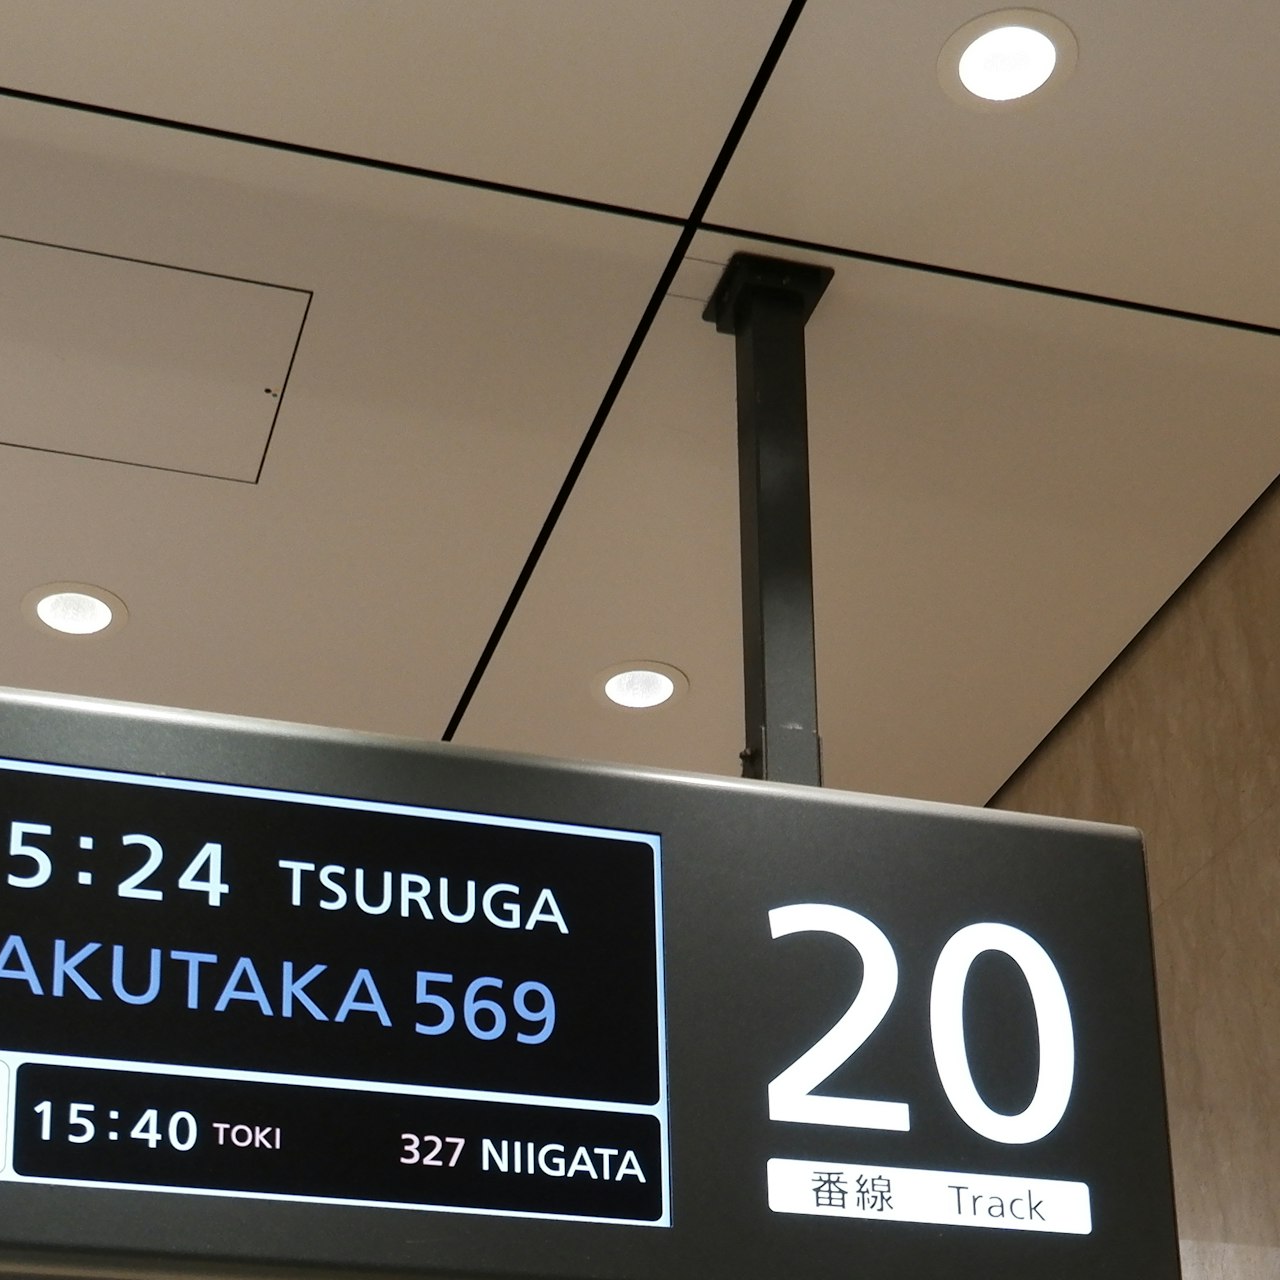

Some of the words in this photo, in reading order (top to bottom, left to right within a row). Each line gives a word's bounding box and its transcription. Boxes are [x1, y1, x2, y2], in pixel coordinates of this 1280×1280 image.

[278, 859, 569, 935] TSURUGA
[414, 970, 557, 1045] 569
[767, 902, 1075, 1145] 20
[32, 1100, 198, 1152] 15:40
[212, 1122, 282, 1150] TOKI
[399, 1133, 467, 1168] 327
[480, 1138, 647, 1184] NIIGATA
[811, 1170, 895, 1213] 番線
[947, 1184, 1046, 1223] Track
